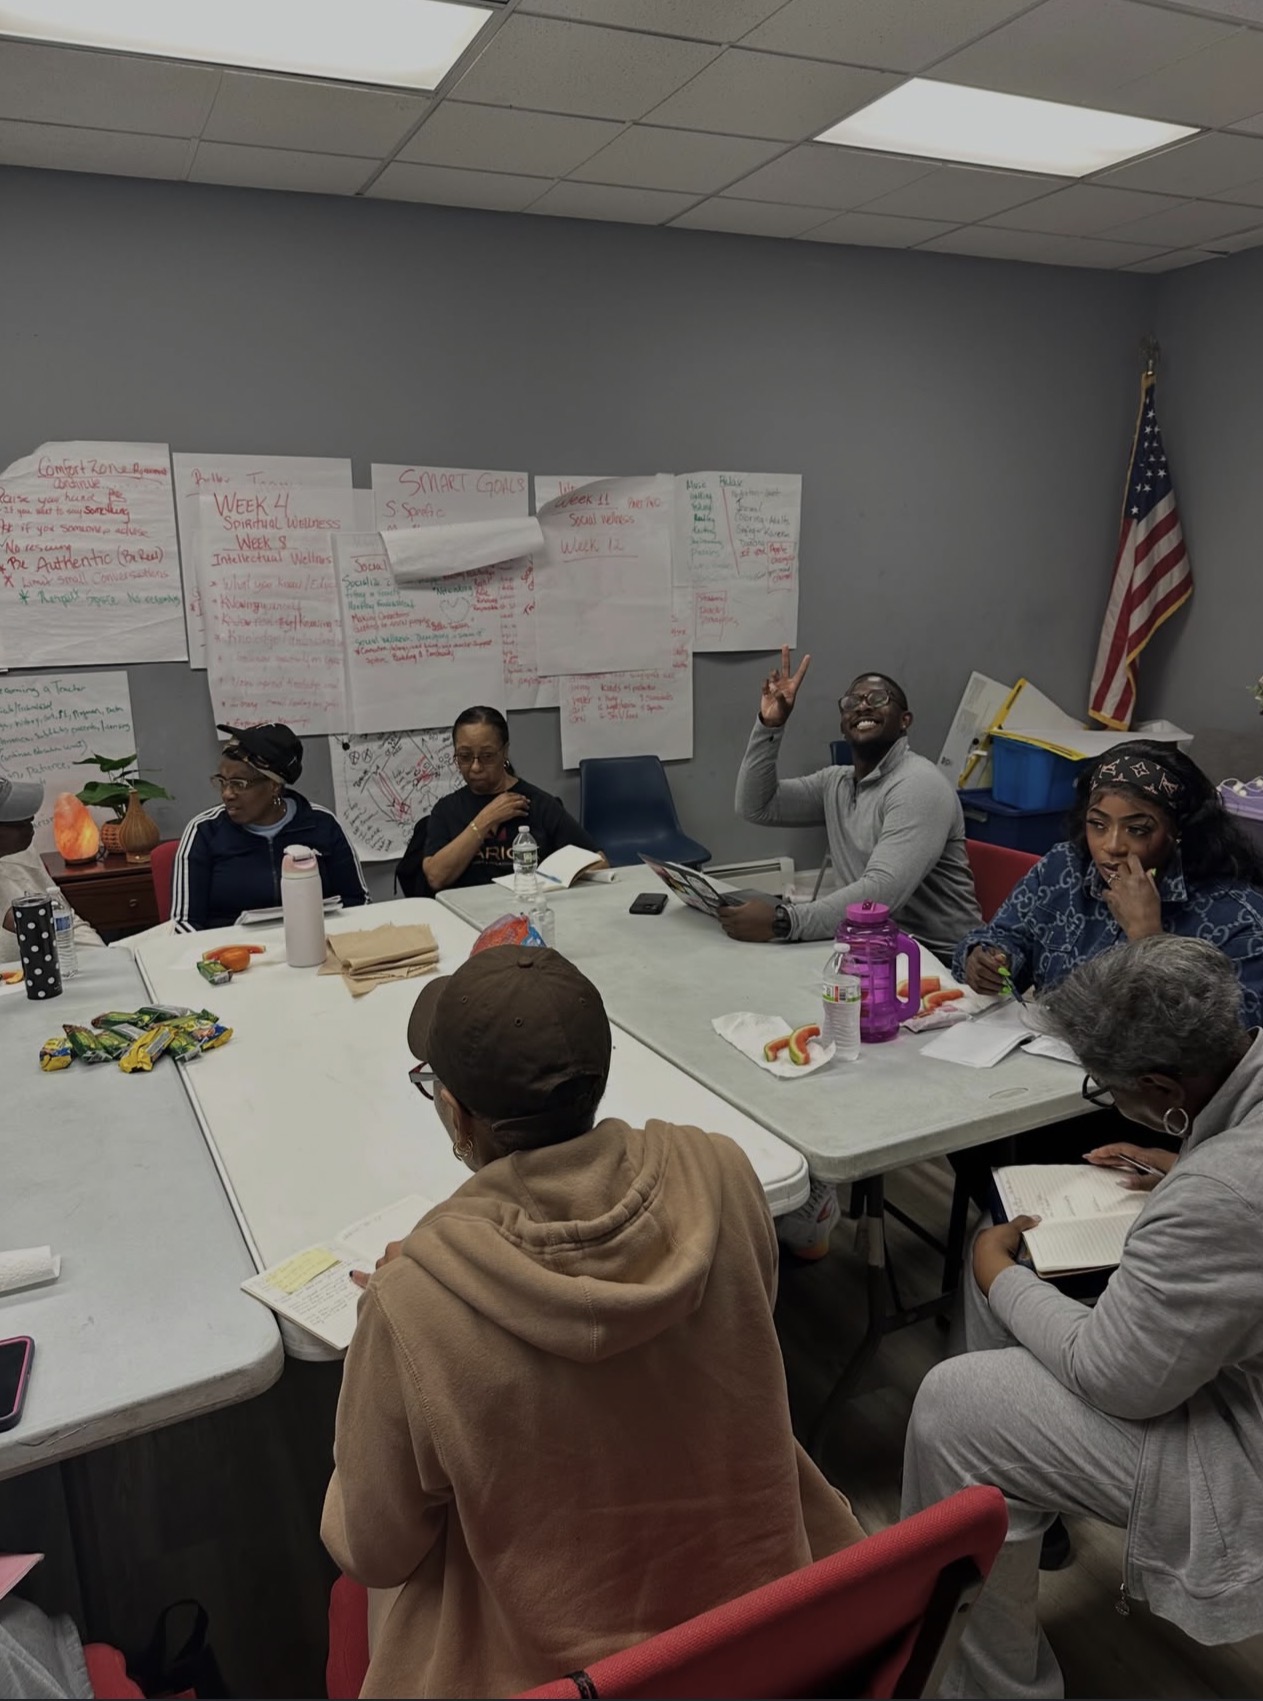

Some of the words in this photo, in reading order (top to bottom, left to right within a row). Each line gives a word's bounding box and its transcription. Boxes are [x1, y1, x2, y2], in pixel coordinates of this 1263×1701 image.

[399, 468, 469, 497] SMART
[476, 472, 526, 498] GOALS
[274, 493, 290, 519] 4
[37, 548, 113, 573] Authentic
